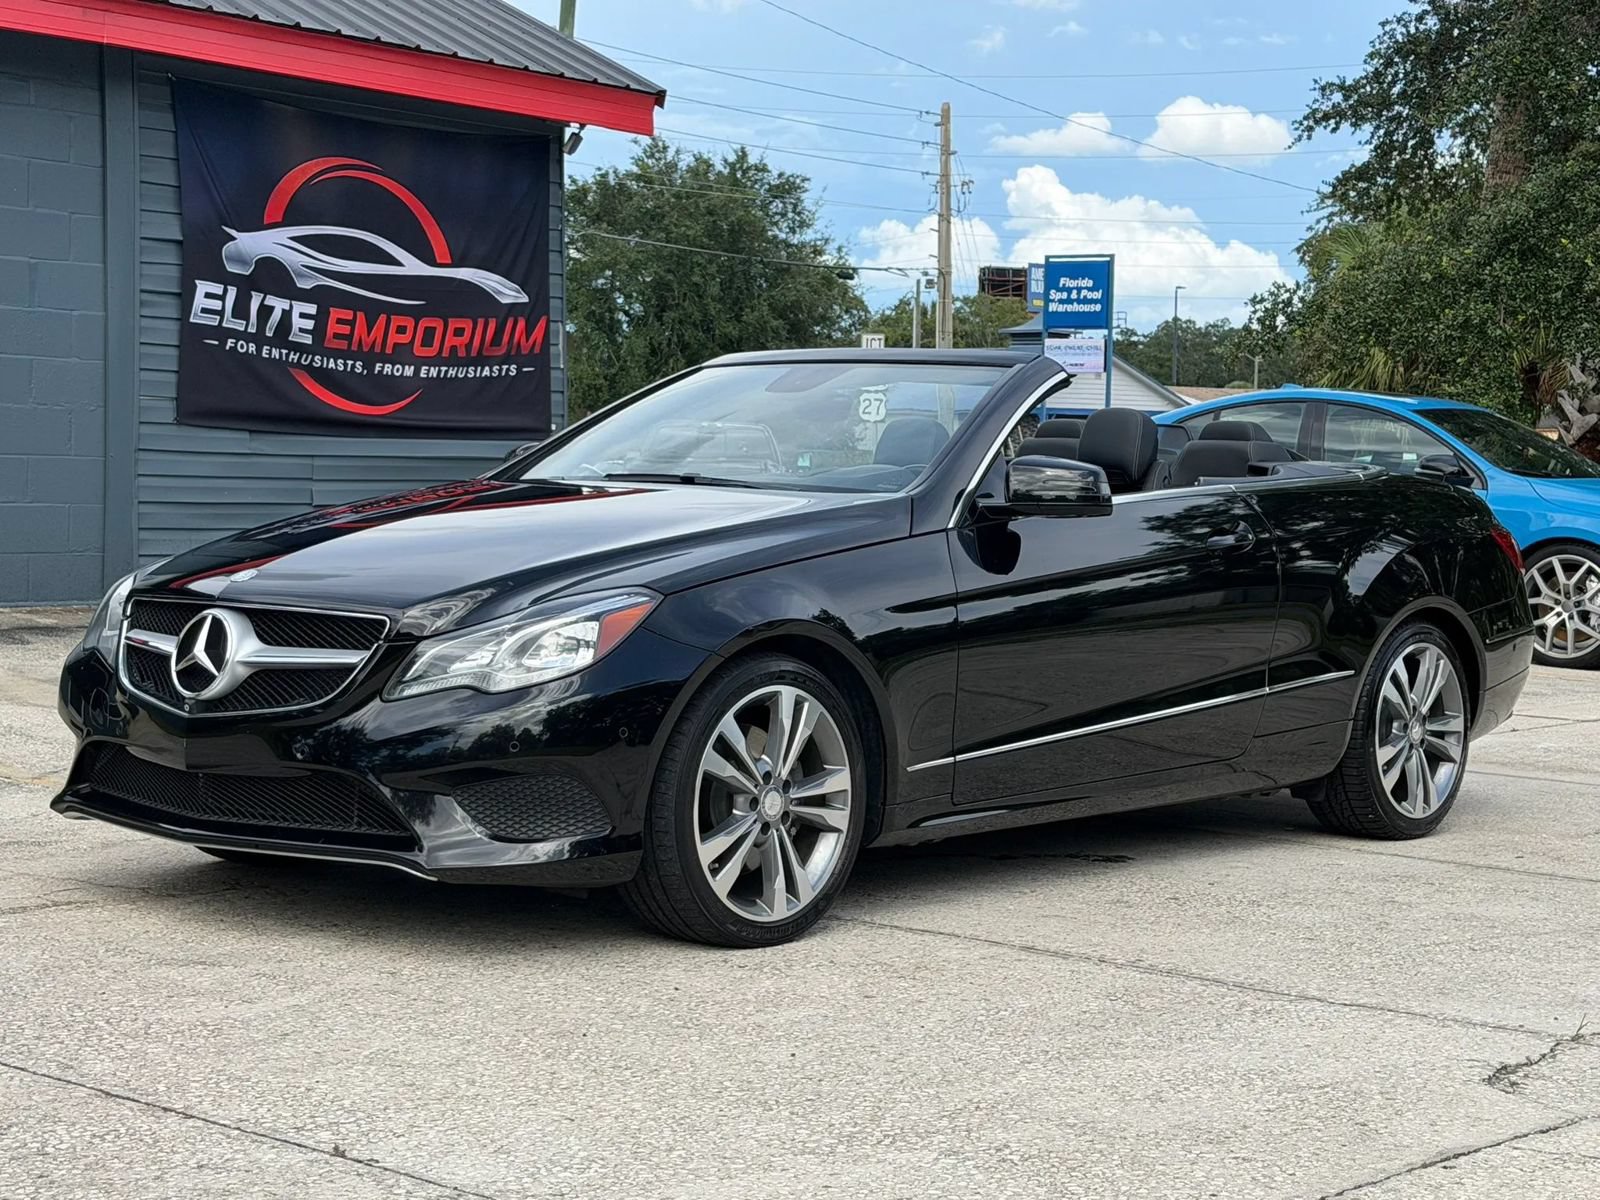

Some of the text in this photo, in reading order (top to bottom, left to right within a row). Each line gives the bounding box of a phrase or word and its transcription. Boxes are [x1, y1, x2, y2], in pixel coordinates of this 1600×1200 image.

[1059, 277, 1093, 288] Florida
[1049, 289, 1102, 300] Spa & Pool
[1048, 302, 1101, 312] Warehouse
[189, 279, 548, 358] ELITE EMPORIUM
[225, 338, 518, 378] FOR ENTHUSIASTS, FROM ENTHUSIASTS
[862, 398, 884, 416] 27
